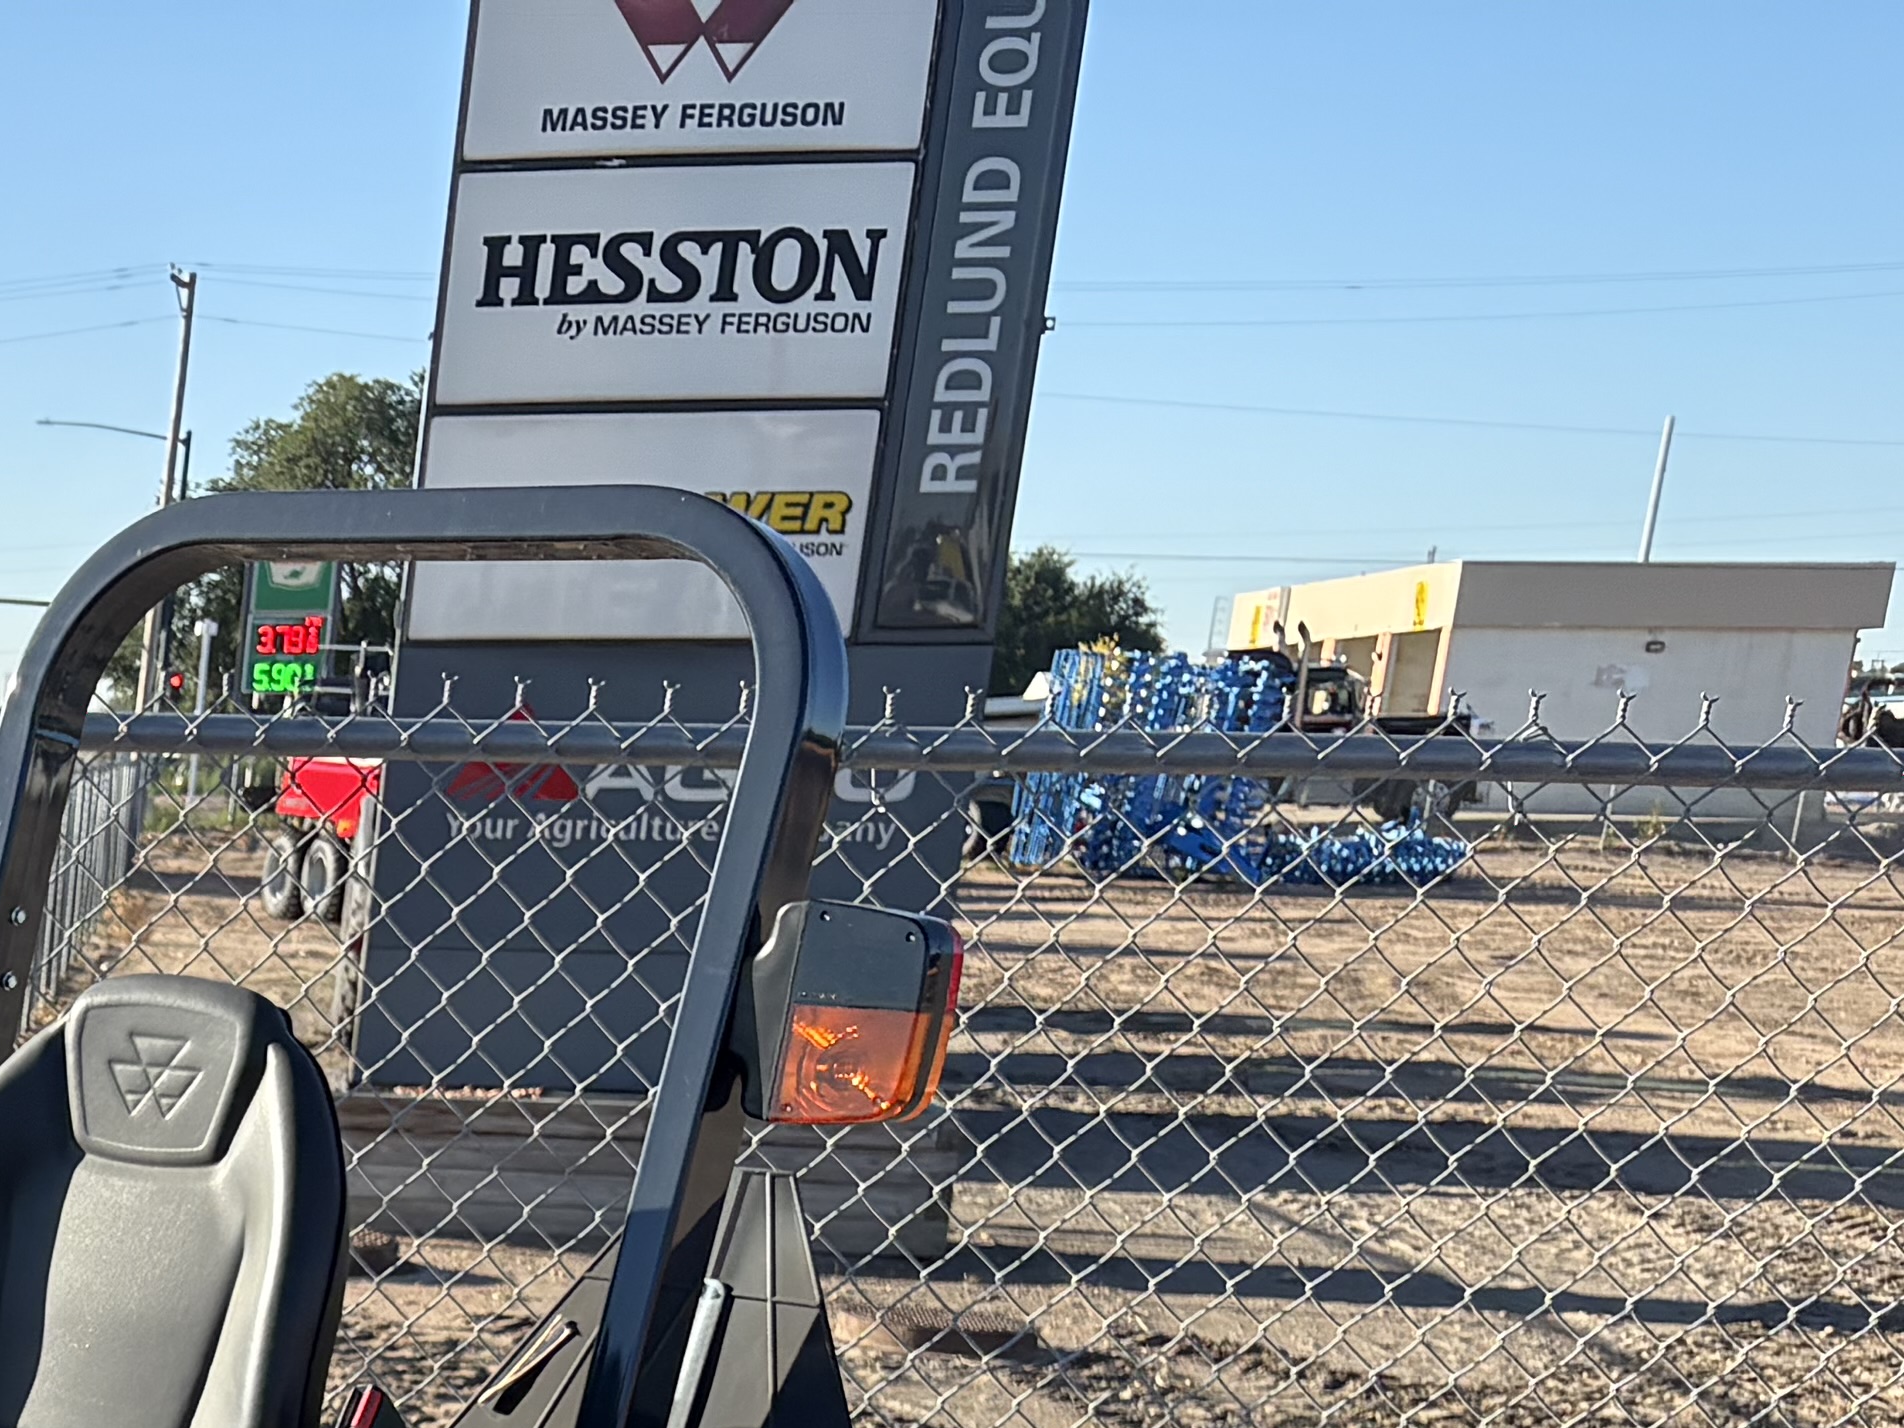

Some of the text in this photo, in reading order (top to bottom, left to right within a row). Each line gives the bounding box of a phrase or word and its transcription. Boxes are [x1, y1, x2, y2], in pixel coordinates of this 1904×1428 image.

[541, 101, 845, 133] MASSEY FERGUSON
[475, 226, 888, 308] HESSTON
[557, 311, 872, 340] by MASSEY FERGUSON
[919, 156, 1021, 494] REDLUND
